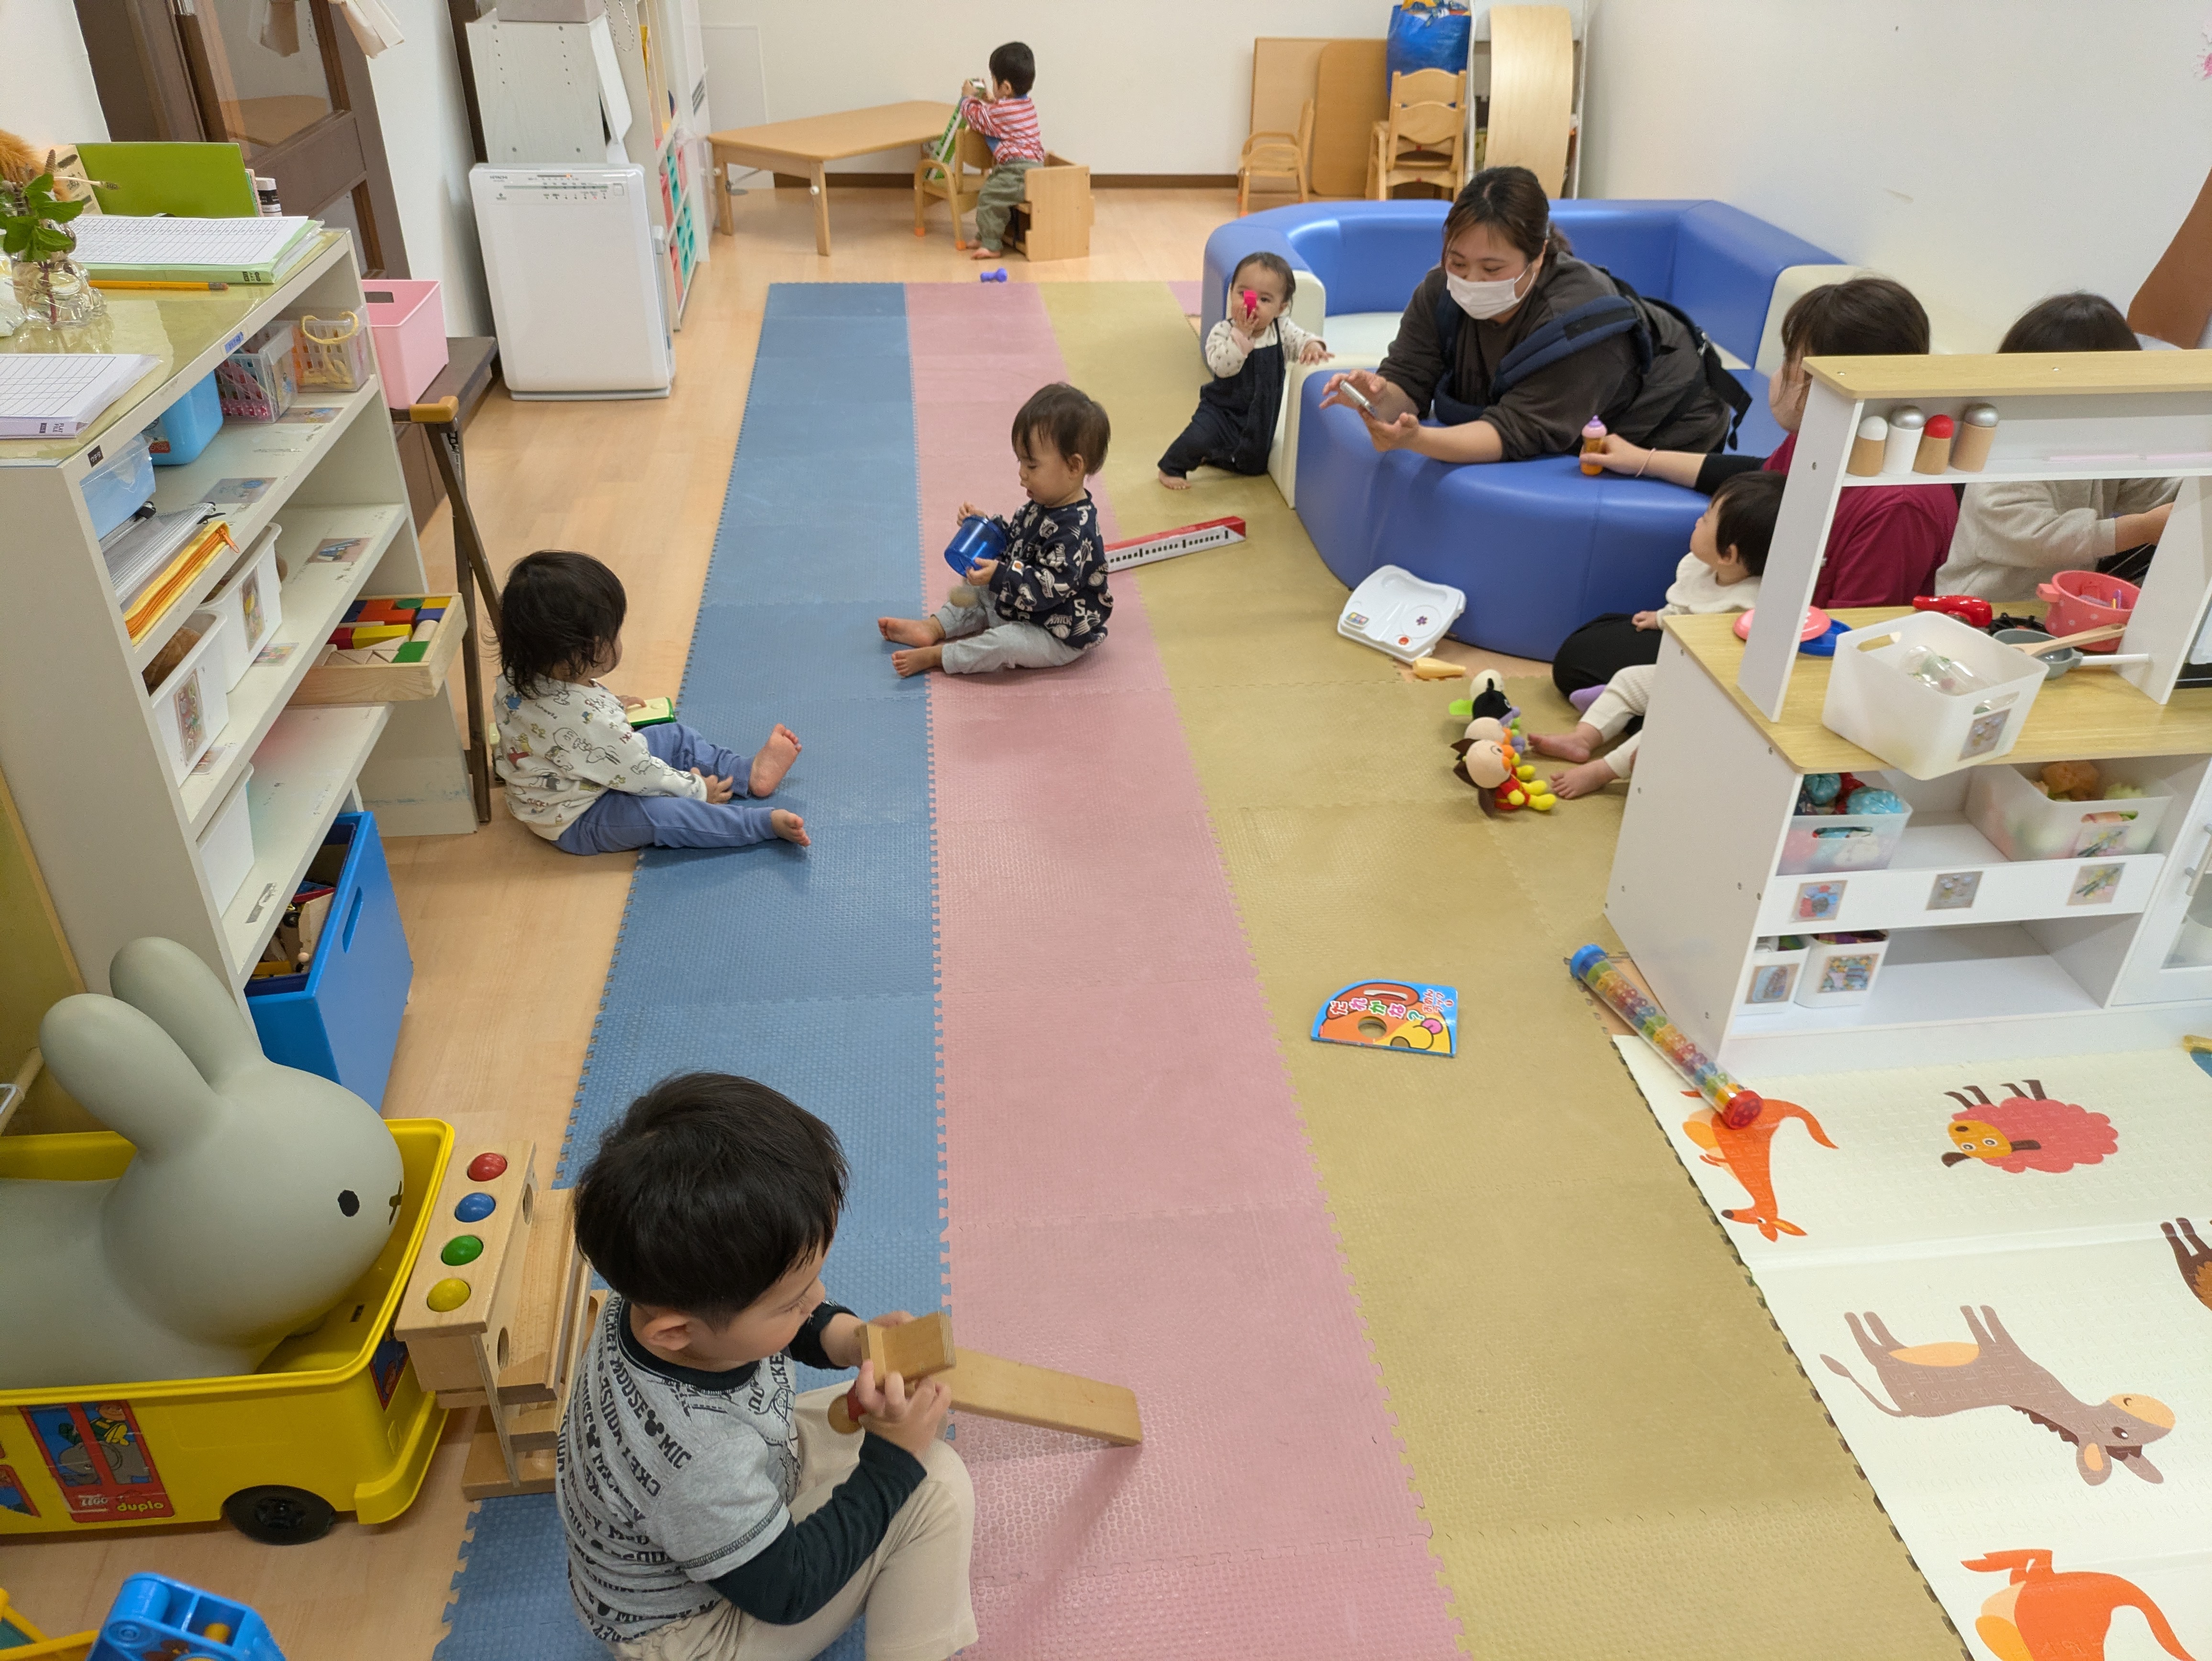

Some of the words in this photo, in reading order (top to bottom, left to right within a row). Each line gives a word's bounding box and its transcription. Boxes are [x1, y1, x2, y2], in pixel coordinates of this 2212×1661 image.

[609, 1355, 649, 1419] MOUSE
[658, 1433, 692, 1469] MIC
[117, 1500, 164, 1513] duplo
